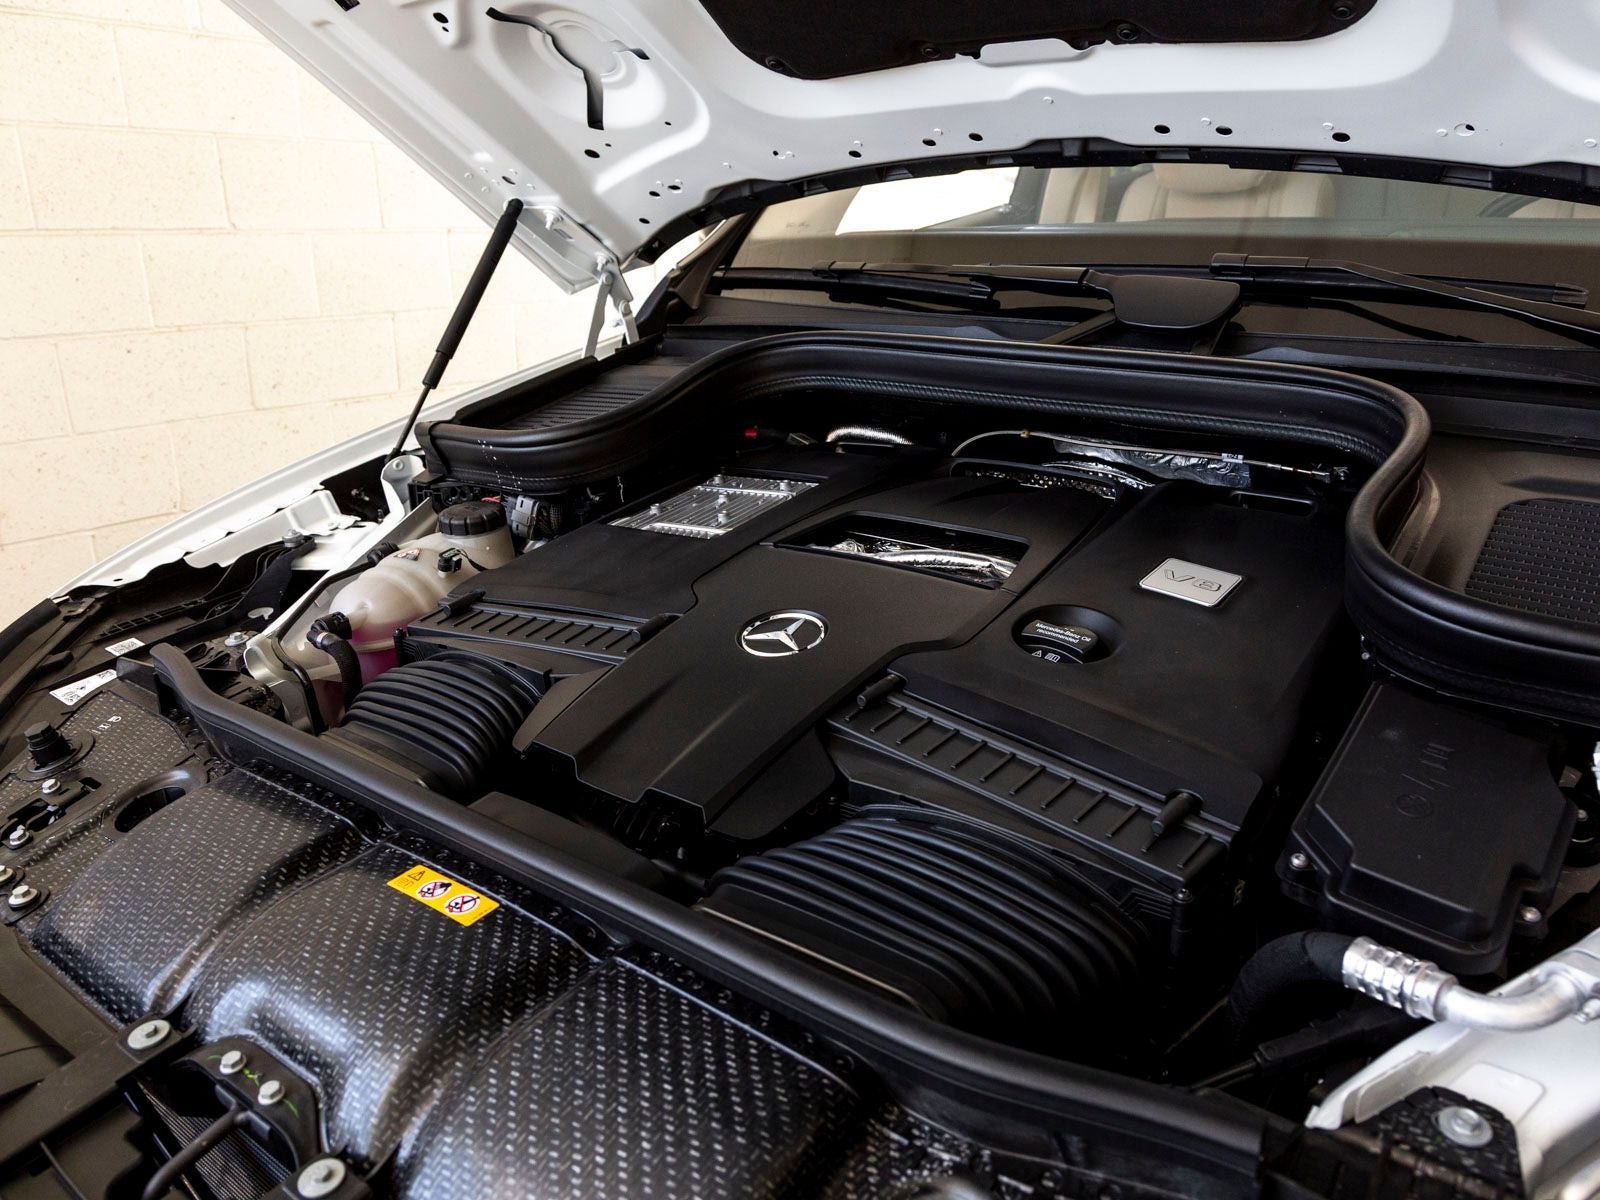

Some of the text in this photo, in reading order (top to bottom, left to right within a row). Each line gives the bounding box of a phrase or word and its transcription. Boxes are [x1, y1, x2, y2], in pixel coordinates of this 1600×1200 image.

[1164, 568, 1222, 592] V8
[1036, 622, 1081, 639] Mercedes-Benz
[1036, 628, 1080, 644] recommended
